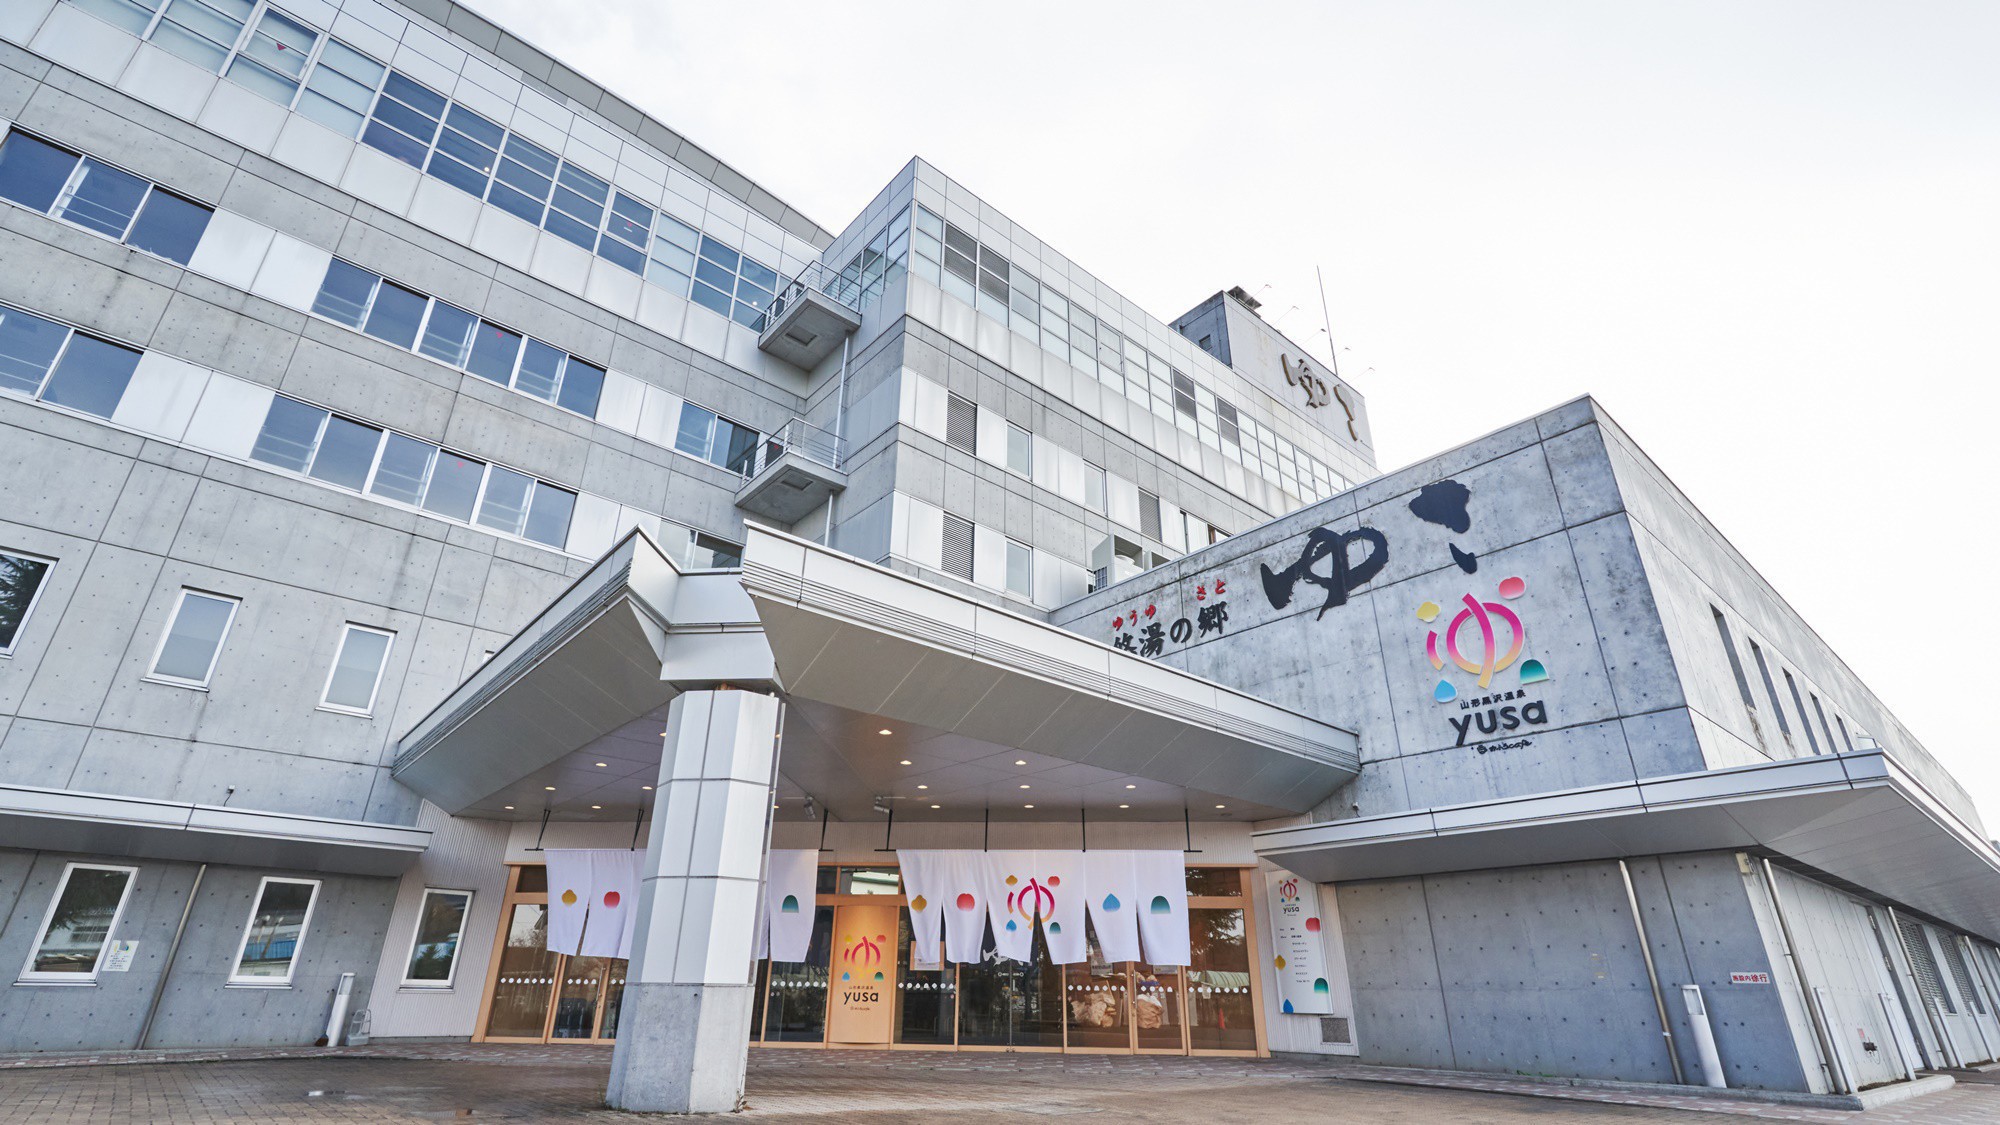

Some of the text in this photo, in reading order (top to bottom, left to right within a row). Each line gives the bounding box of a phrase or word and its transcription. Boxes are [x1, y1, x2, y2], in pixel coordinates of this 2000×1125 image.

[1196, 579, 1226, 601] さと
[1460, 689, 1527, 710] 山形黒沢温泉
[1448, 700, 1548, 748] yusa
[1283, 906, 1299, 914] yusa
[843, 991, 879, 1005] yusa
